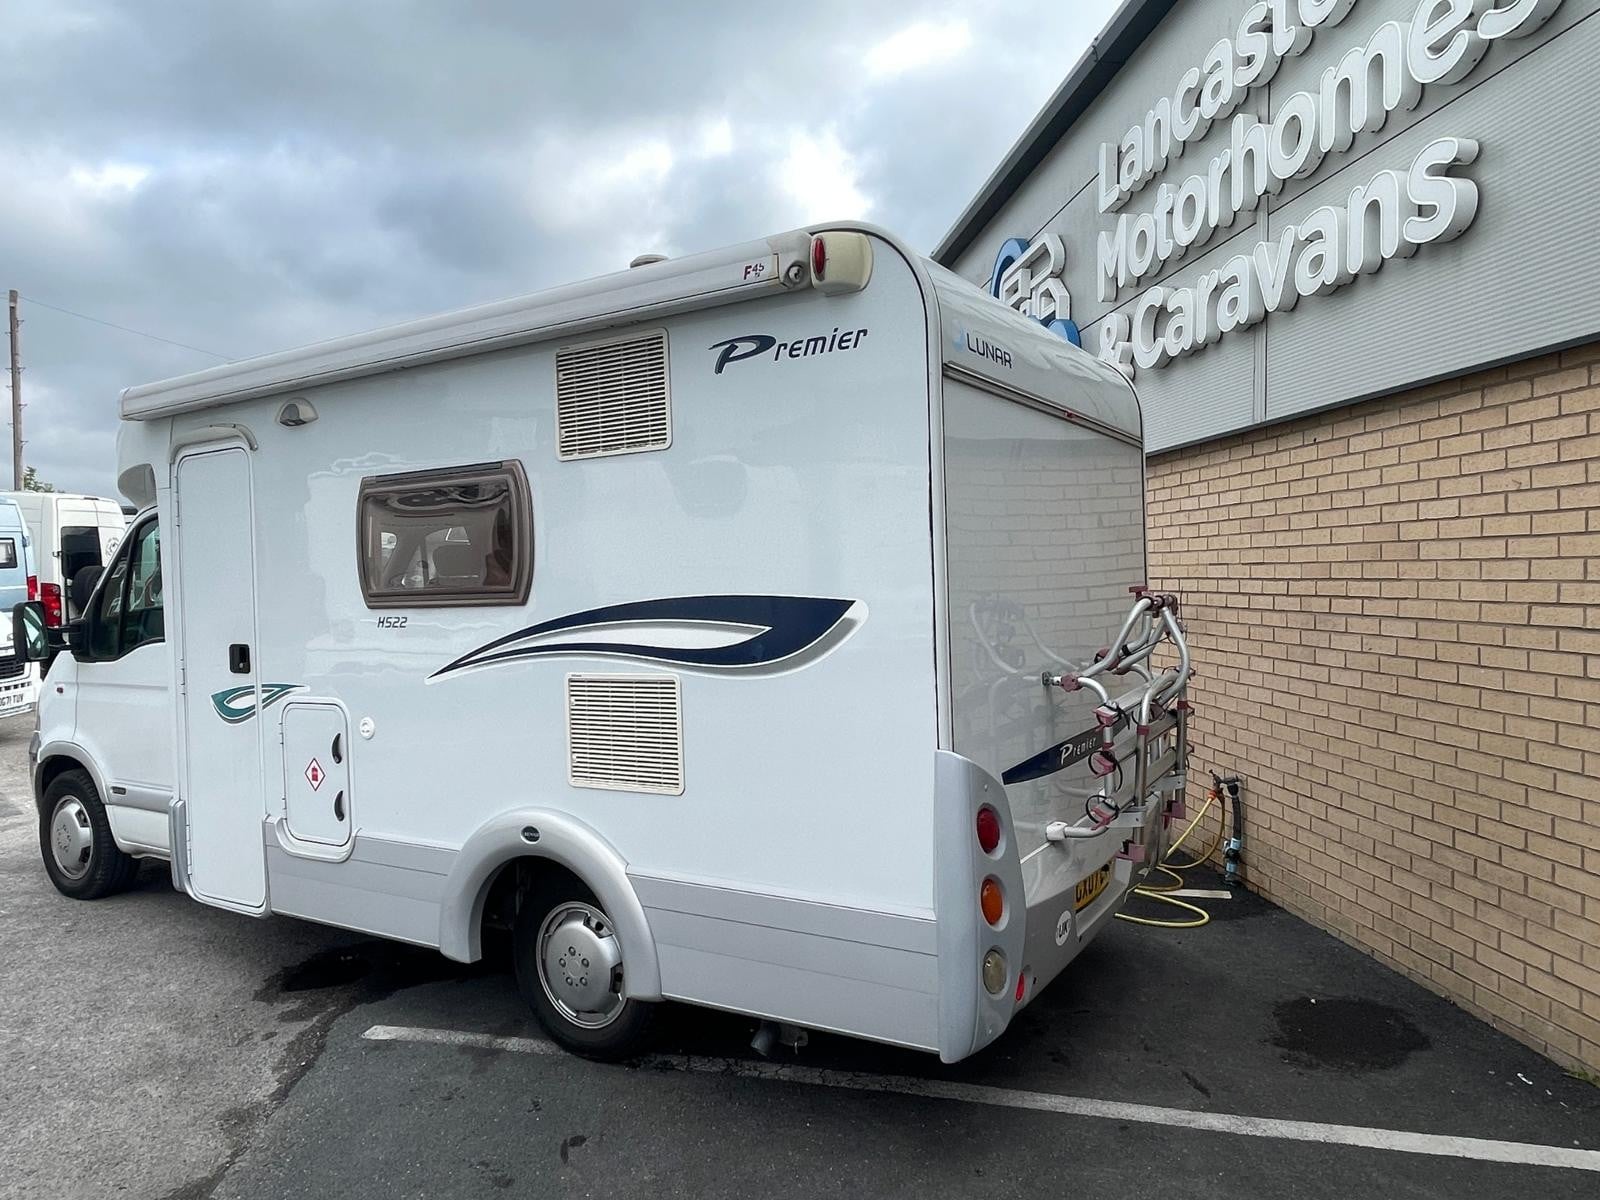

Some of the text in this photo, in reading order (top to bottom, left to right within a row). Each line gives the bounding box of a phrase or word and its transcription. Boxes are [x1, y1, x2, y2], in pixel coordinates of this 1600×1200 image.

[708, 327, 868, 375] Premier
[966, 332, 1012, 369] LUNAR
[1060, 737, 1097, 765] Premier
[1059, 919, 1069, 938] UK
